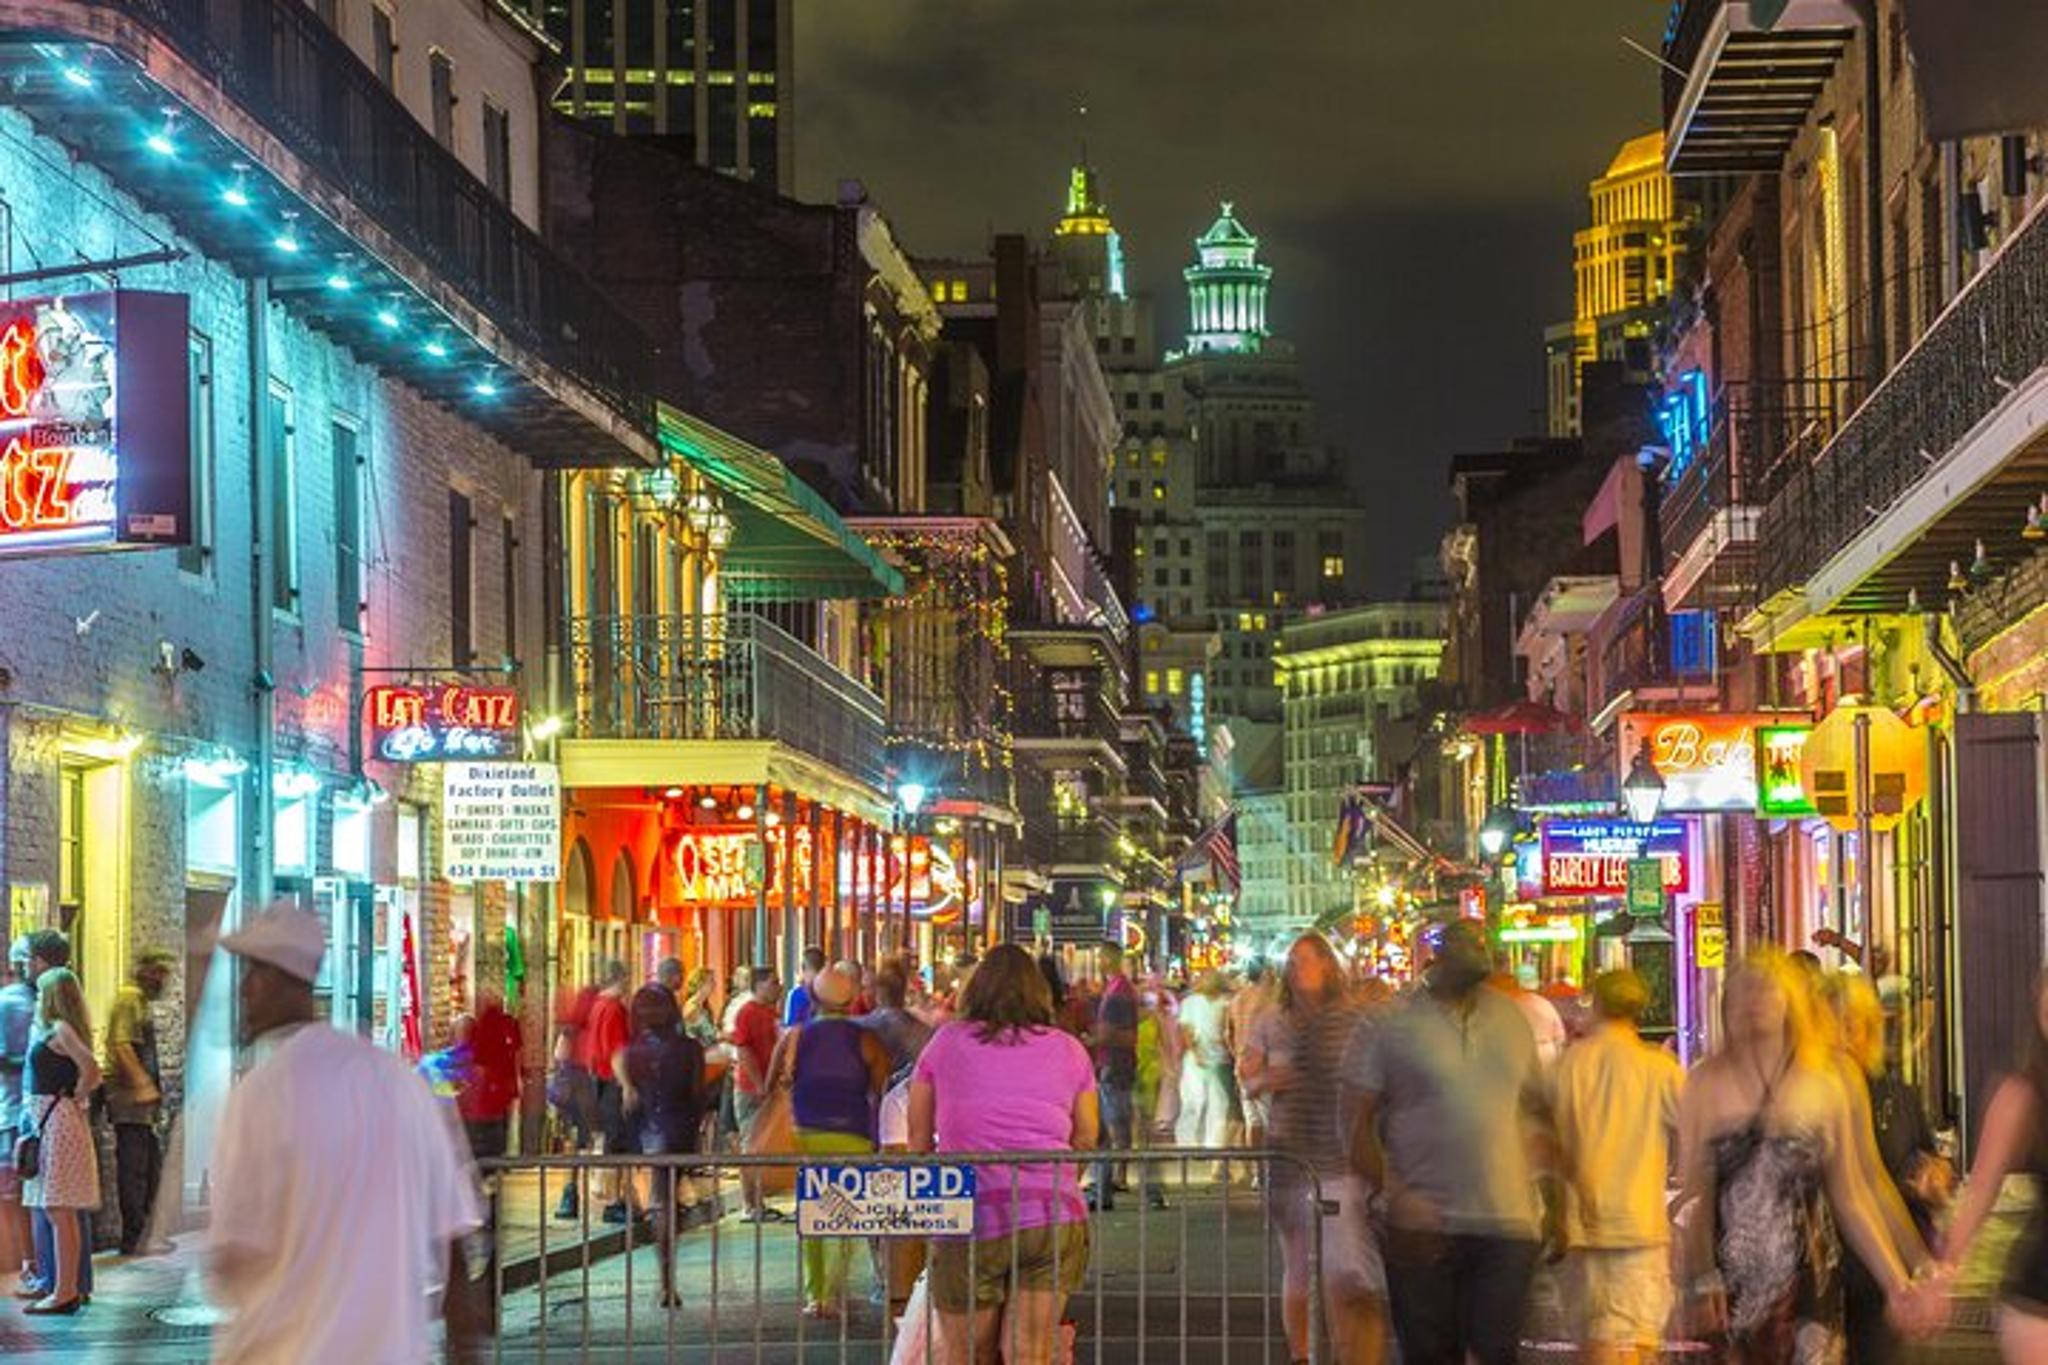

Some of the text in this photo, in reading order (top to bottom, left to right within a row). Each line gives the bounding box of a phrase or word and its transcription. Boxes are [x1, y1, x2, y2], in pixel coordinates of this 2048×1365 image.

[469, 767, 535, 780] Dixieland
[449, 784, 555, 799] Factory Outlet
[513, 804, 551, 816] MASKS
[448, 863, 556, 877] 434 Bourbon St
[1550, 856, 1600, 889] BARELY
[848, 1219, 888, 1231] NOT
